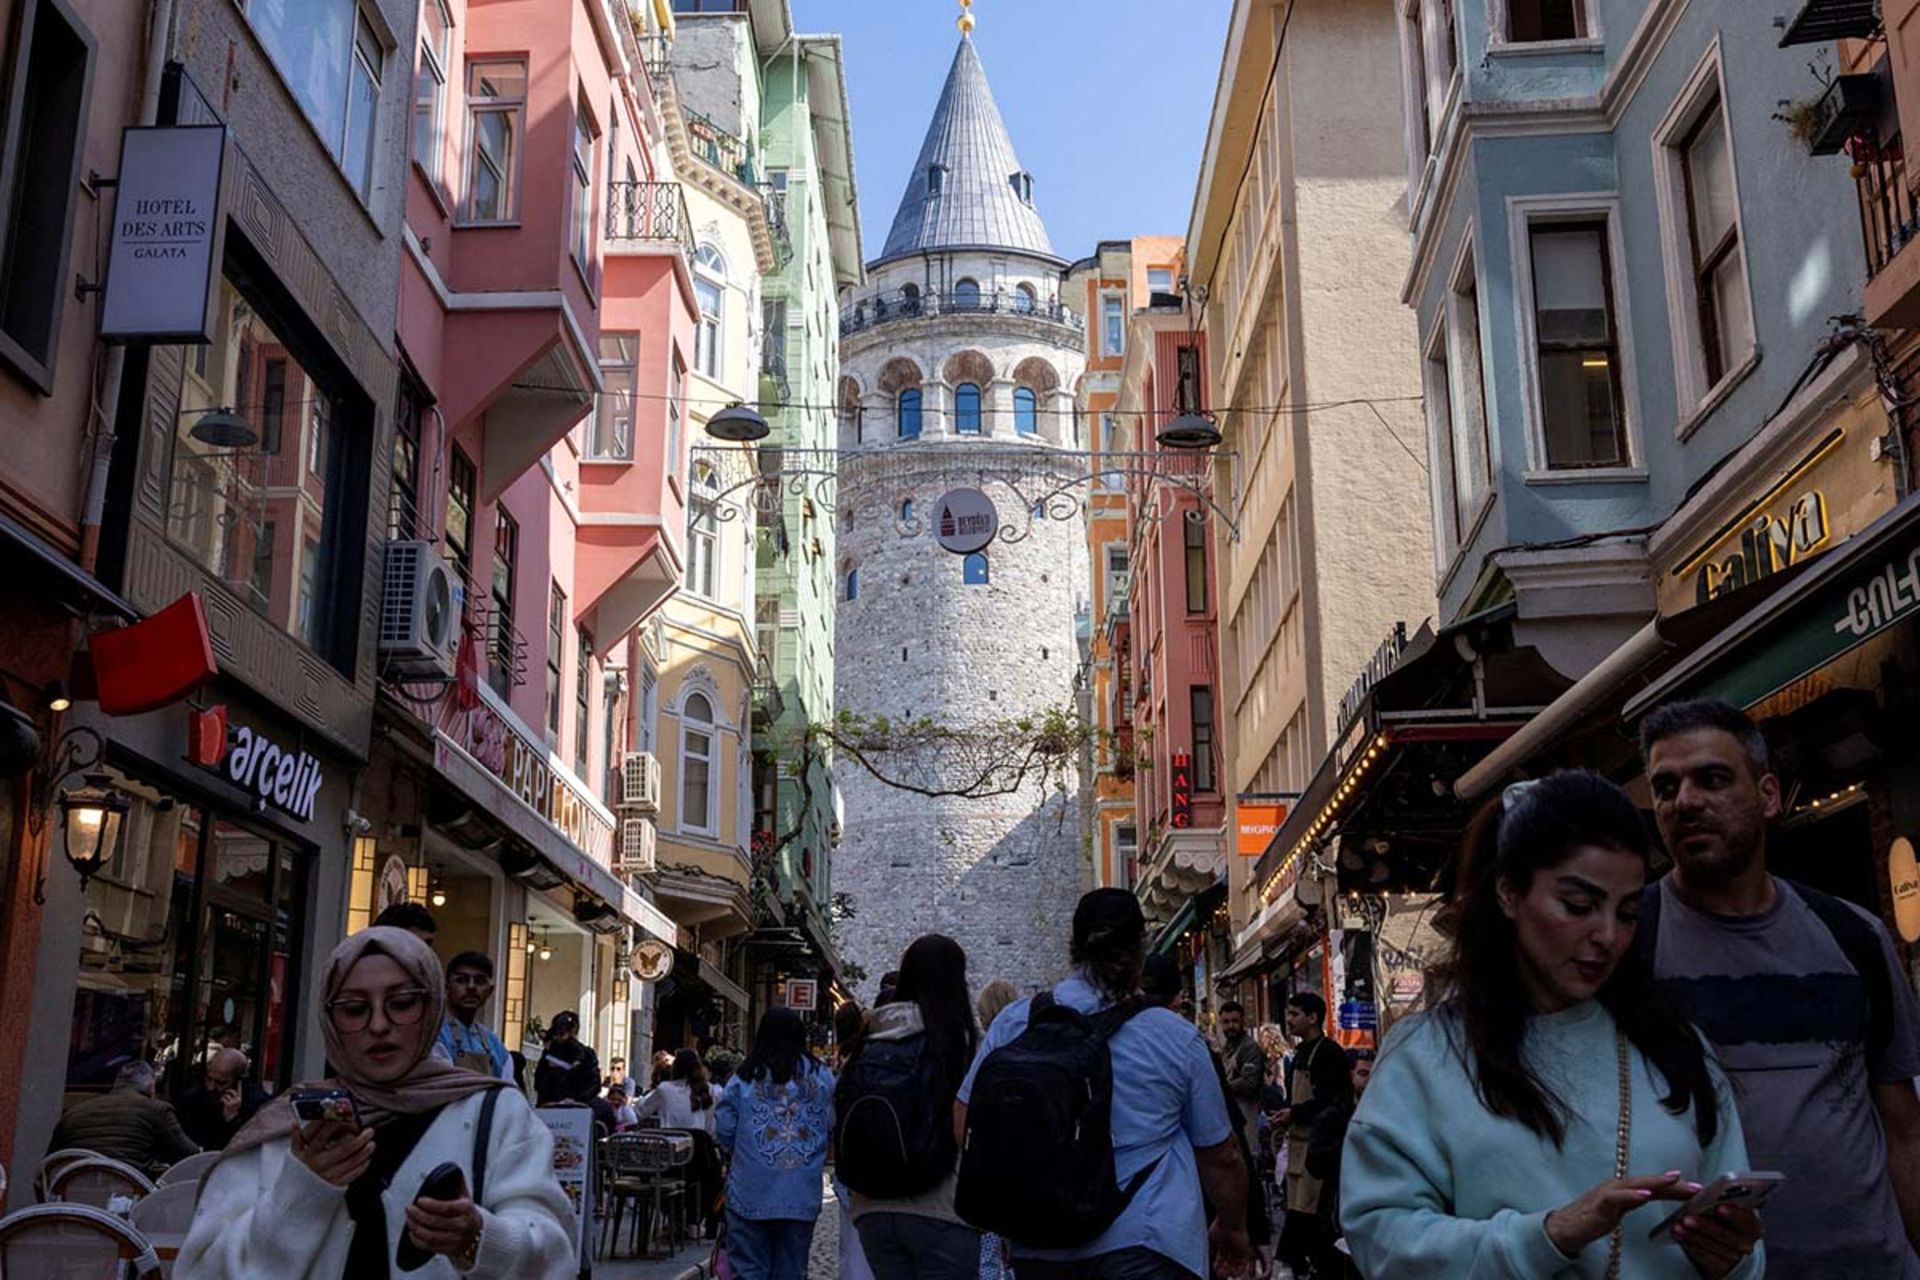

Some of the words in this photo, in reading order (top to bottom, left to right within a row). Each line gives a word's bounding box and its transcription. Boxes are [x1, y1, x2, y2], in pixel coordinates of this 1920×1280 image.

[136, 199, 196, 215] HOTEL
[121, 221, 157, 238] DES
[160, 220, 206, 237] ARTS
[133, 246, 187, 259] GALATA
[229, 726, 323, 822] arçelik
[1240, 824, 1279, 834] MIGRO
[792, 984, 809, 1005] E
